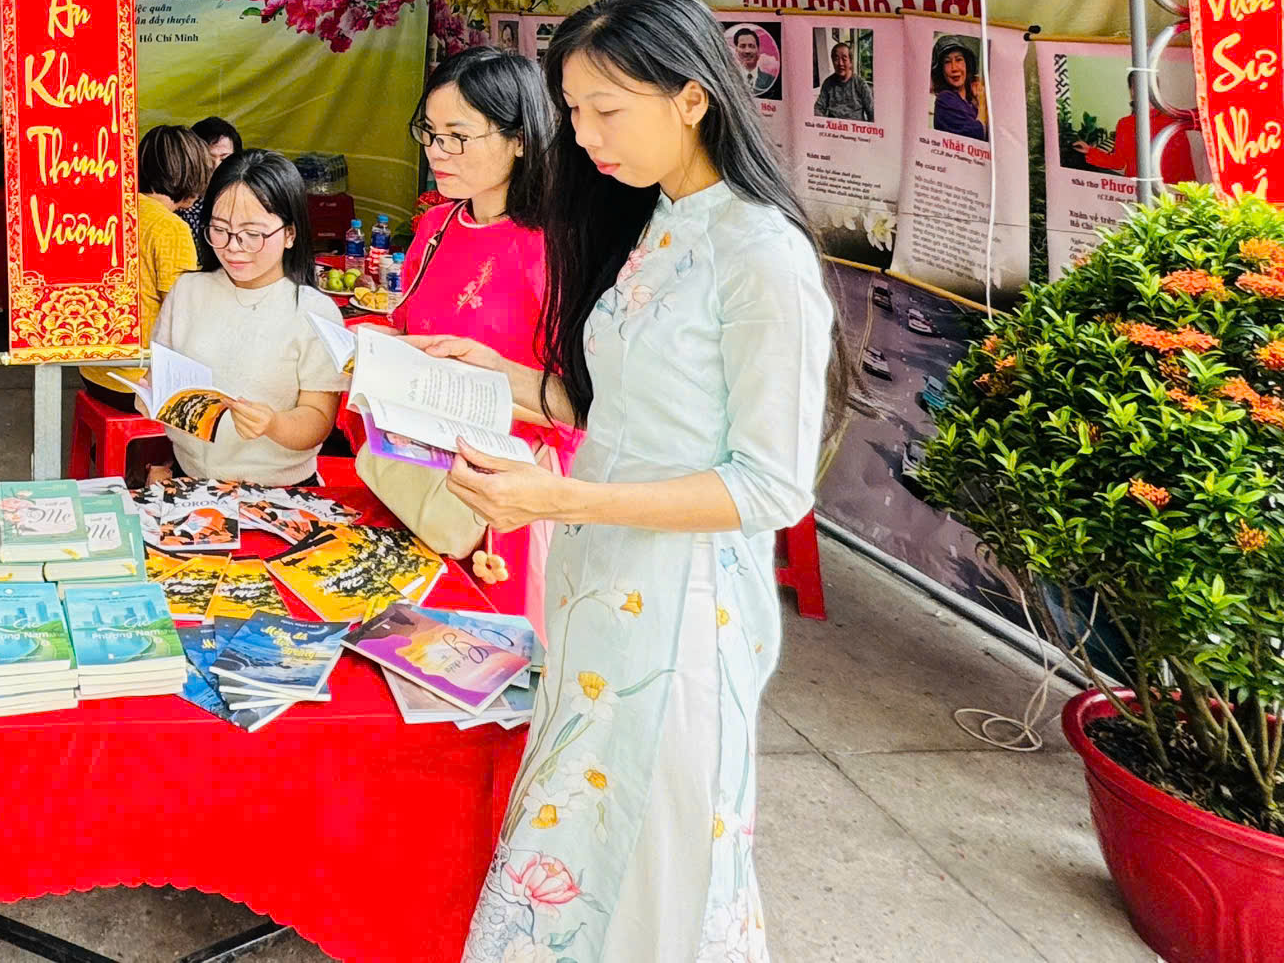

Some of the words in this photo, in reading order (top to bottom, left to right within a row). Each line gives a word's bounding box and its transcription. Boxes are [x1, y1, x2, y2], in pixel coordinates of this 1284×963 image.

[134, 4, 147, 13] iệc
[149, 4, 172, 14] quân
[139, 33, 153, 43] Hồ
[155, 33, 172, 43] Chí
[174, 33, 199, 43] Minh
[1212, 32, 1278, 94] Sự
[24, 51, 119, 133] Khang
[942, 137, 965, 153] Nhật
[1214, 106, 1282, 173] Như
[26, 124, 119, 187] Thịnh
[30, 194, 119, 267] Vượng
[174, 499, 229, 509] CORONA
[24, 630, 49, 638] Nam
[135, 628, 160, 637] Nam
